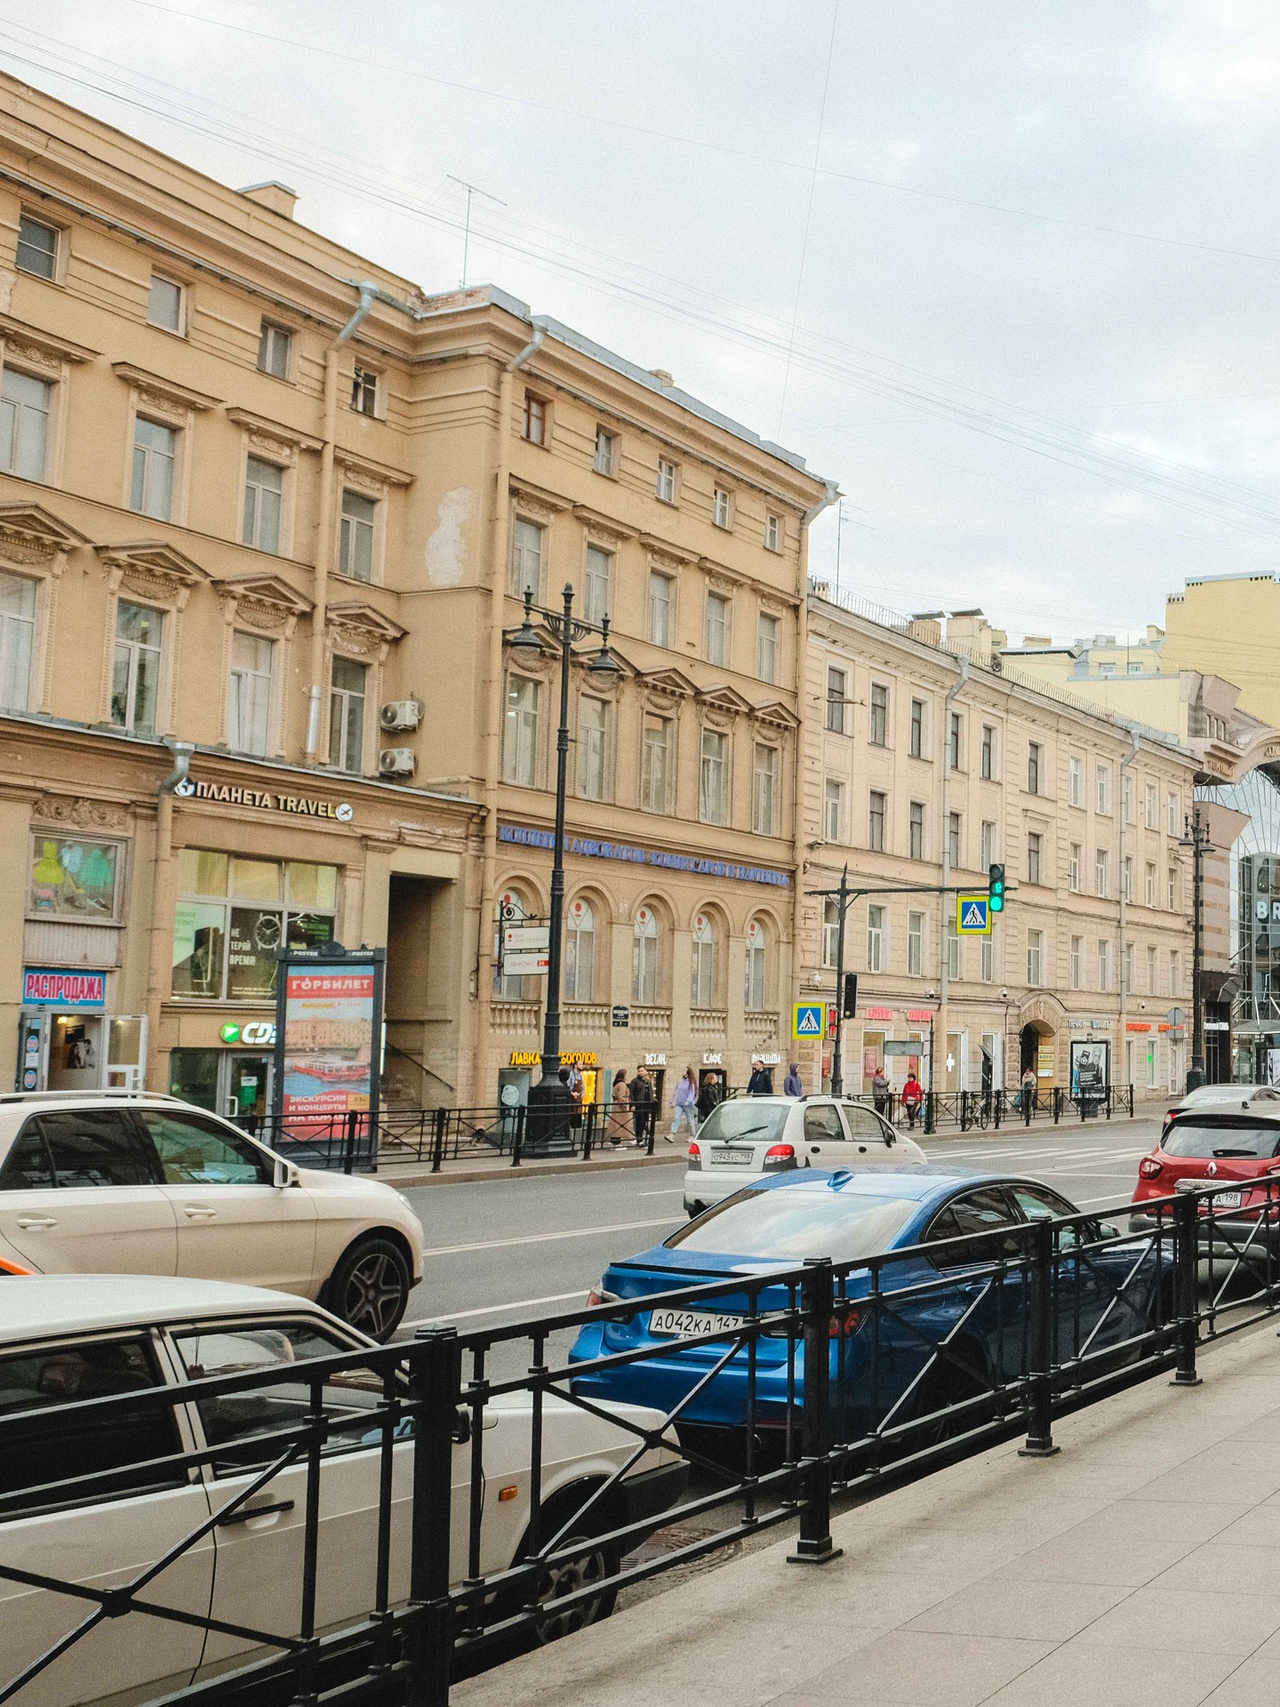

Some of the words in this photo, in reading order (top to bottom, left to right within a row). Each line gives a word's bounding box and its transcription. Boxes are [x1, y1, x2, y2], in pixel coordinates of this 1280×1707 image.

[196, 781, 272, 808] ПЛАНЕТА
[277, 795, 337, 818] TRAVEL
[230, 928, 241, 938] НЕ
[230, 940, 251, 952] ТЕРЯЙ
[25, 973, 103, 1004] РАСПРОДАЖА
[292, 976, 370, 990] ГОРБИЛЕТ
[511, 1052, 541, 1065] ЛАВКА
[703, 1053, 723, 1065] КАФЕ
[289, 1094, 347, 1103] ЭКСКУРСИИ
[288, 1104, 296, 1112] И
[297, 1103, 346, 1112] КОНЦЕРТЫ
[1224, 1193, 1239, 1202] 198
[654, 1312, 711, 1333] А042КА
[716, 1316, 739, 1330] 147
